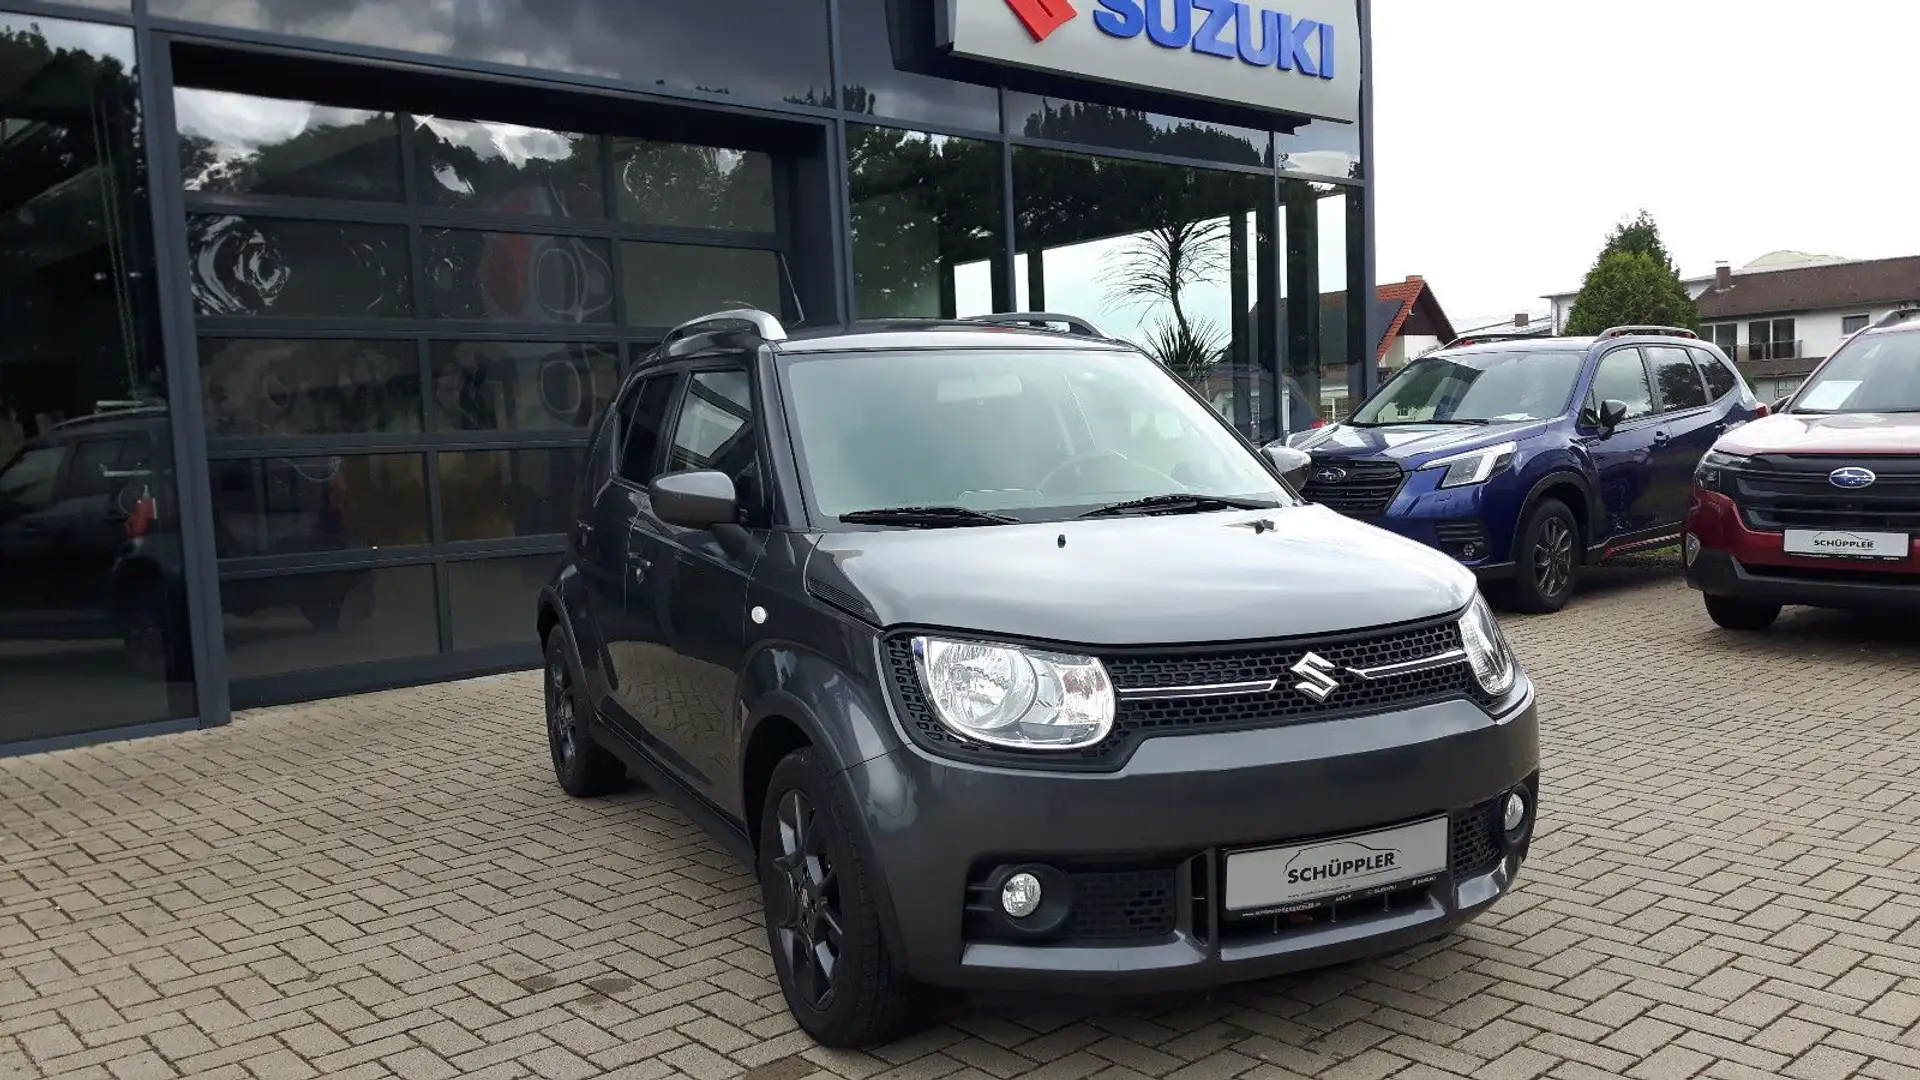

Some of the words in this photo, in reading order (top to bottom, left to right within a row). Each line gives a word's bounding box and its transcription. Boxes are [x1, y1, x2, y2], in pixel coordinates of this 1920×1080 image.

[1093, 0, 1335, 80] SUZUKI
[1813, 538, 1875, 549] SCHÜPPLER
[1287, 852, 1395, 884] SCHÜPPLER
